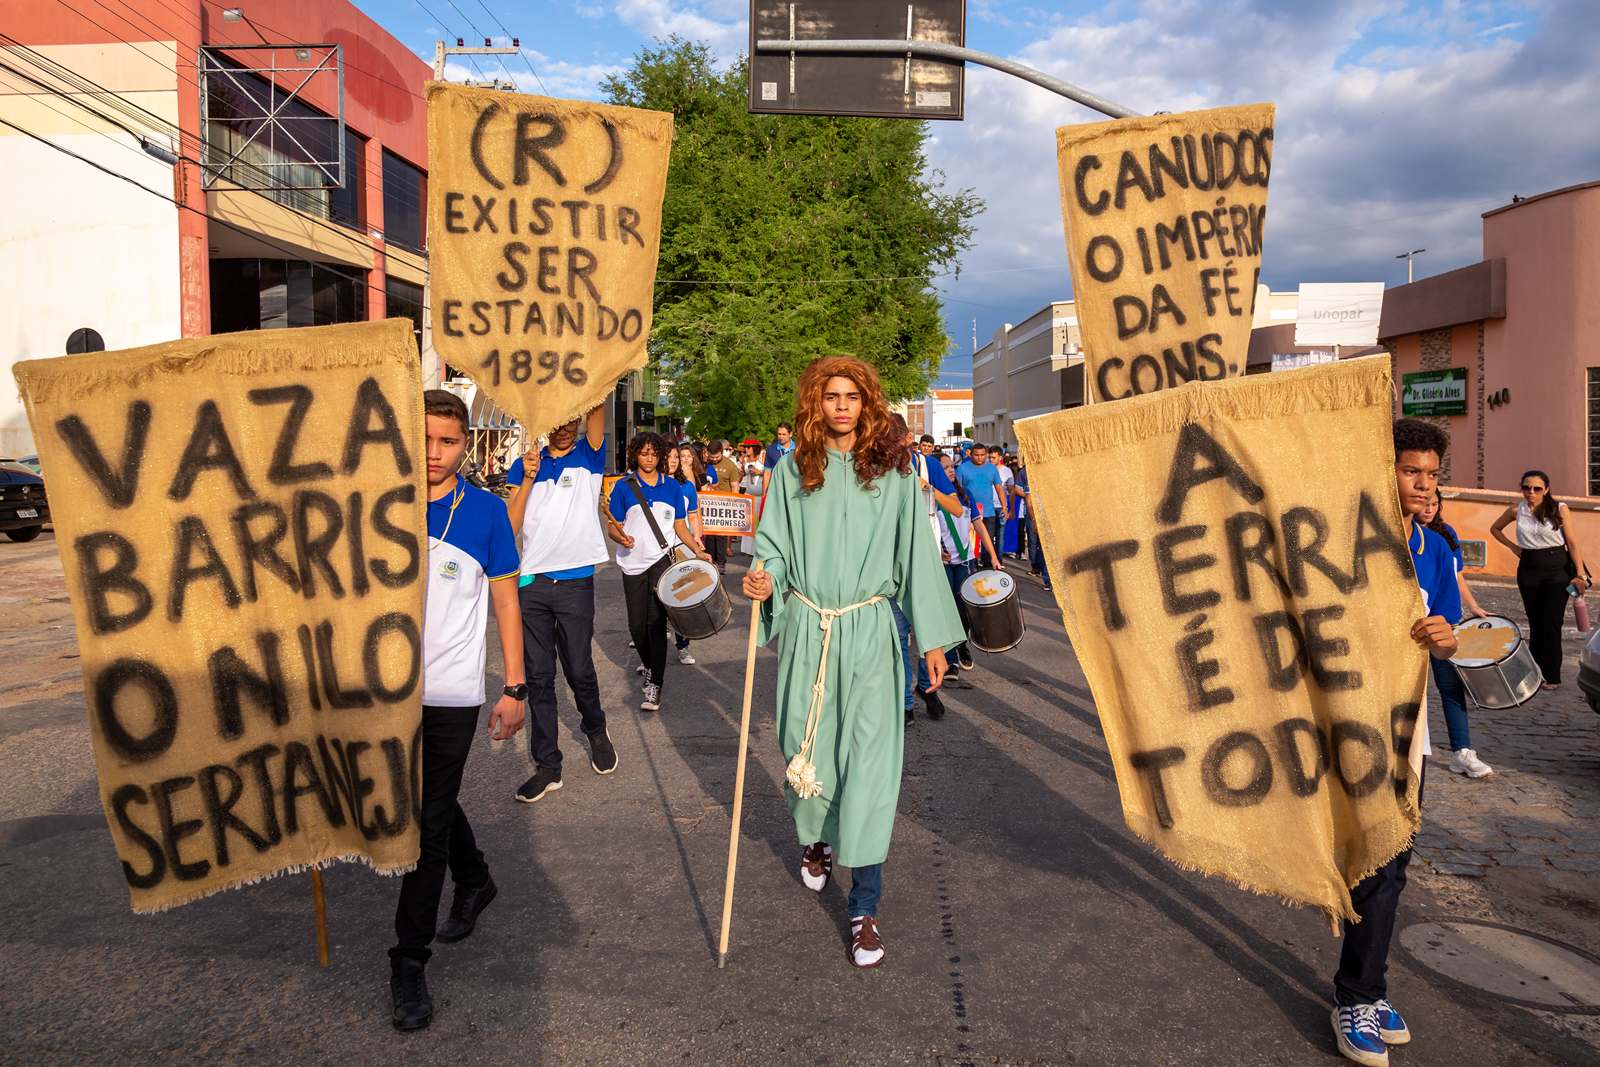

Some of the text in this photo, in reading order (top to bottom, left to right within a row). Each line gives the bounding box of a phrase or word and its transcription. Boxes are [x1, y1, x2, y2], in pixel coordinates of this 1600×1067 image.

[445, 192, 645, 248] EXISTIR
[496, 241, 601, 300] SER
[1085, 234, 1124, 283] O
[441, 299, 643, 342] ESTANDO
[1112, 283, 1187, 341] DA
[1199, 260, 1242, 317] FÉ
[1313, 309, 1363, 323] unopar
[480, 349, 588, 387] 1896
[1413, 389, 1421, 400] Dr.
[1445, 387, 1460, 399] Alves
[1487, 387, 1510, 411] 140
[56, 377, 413, 510] VAZA
[1155, 421, 1265, 526] A
[700, 499, 738, 508] ASSASSINATOS
[74, 485, 420, 635] BARRIS
[1066, 490, 1417, 631] TERRA
[96, 611, 423, 763] O NILO
[1175, 604, 1364, 713] É DE
[111, 724, 423, 889] SERTANEJ
